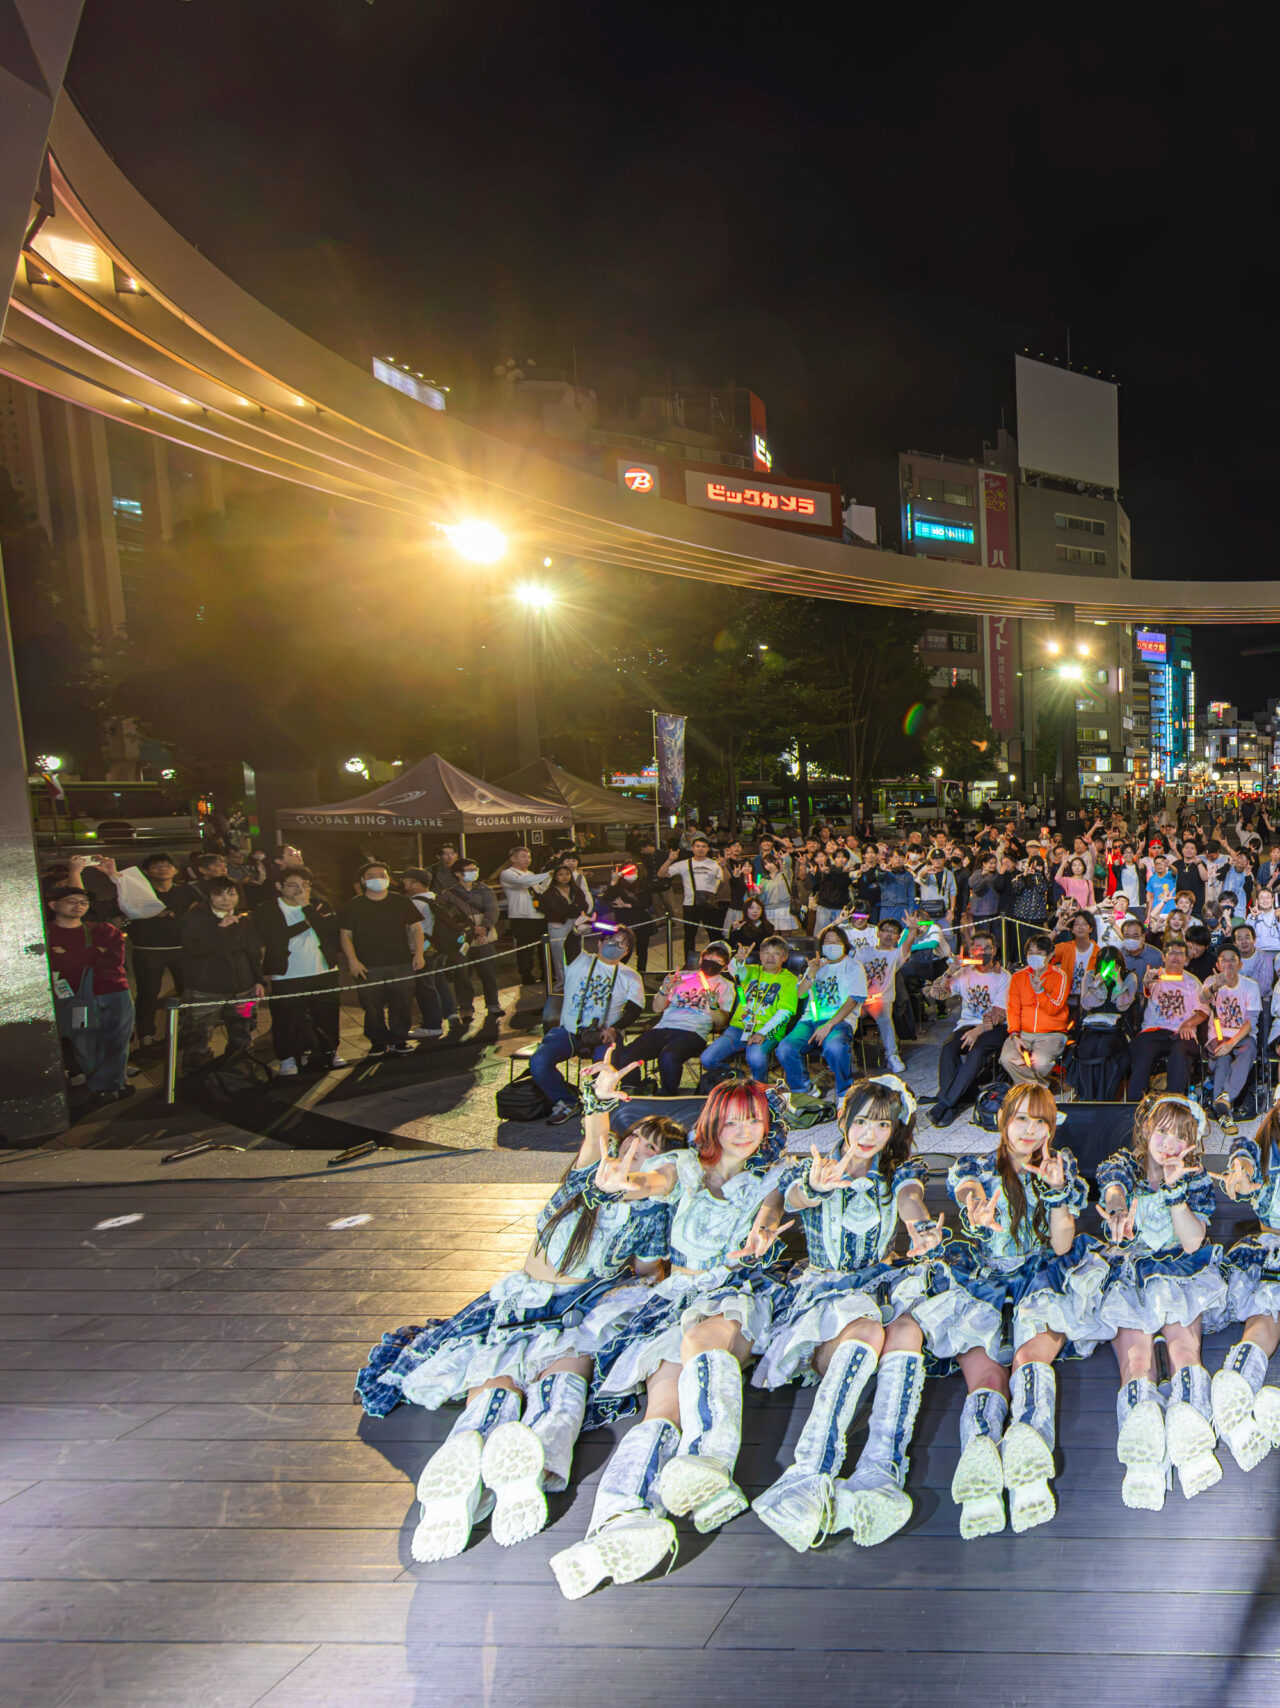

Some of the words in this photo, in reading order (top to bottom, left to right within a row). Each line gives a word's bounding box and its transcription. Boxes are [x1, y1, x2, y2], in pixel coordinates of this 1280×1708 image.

[706, 482, 816, 516] ビックカメラ
[295, 815, 349, 825] GLOBAL
[354, 815, 387, 825] RING
[391, 816, 444, 827] THEATRE
[475, 816, 510, 826] GLOBAL
[512, 815, 532, 825] RING
